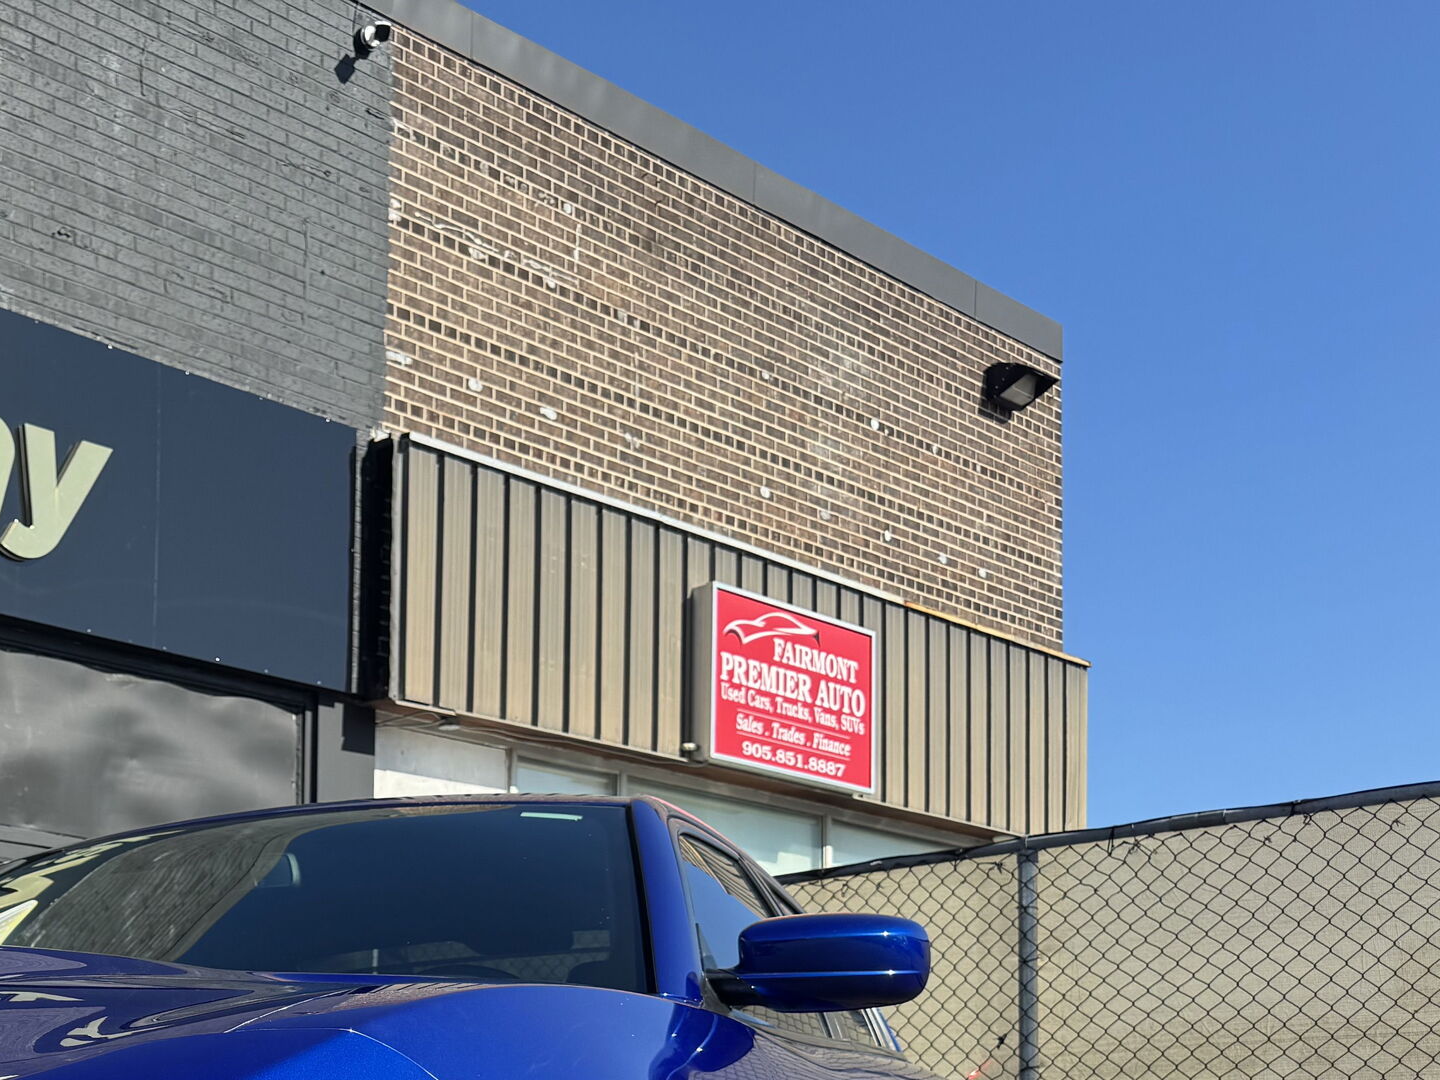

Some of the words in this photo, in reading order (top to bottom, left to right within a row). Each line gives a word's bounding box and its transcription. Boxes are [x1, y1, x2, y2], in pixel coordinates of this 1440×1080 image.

[720, 651, 812, 703] PREMIER
[815, 680, 865, 717] AUTO
[773, 637, 859, 684] FAIRMONT
[720, 683, 745, 703] Used
[747, 689, 773, 712] Cars,
[775, 697, 812, 723] Trucks,
[814, 707, 839, 730] Vans,
[840, 714, 865, 735] SUVs
[736, 713, 764, 735] Sales
[771, 722, 805, 745] Trades
[812, 733, 851, 757] Finance
[741, 740, 846, 777] 905.851.8887
